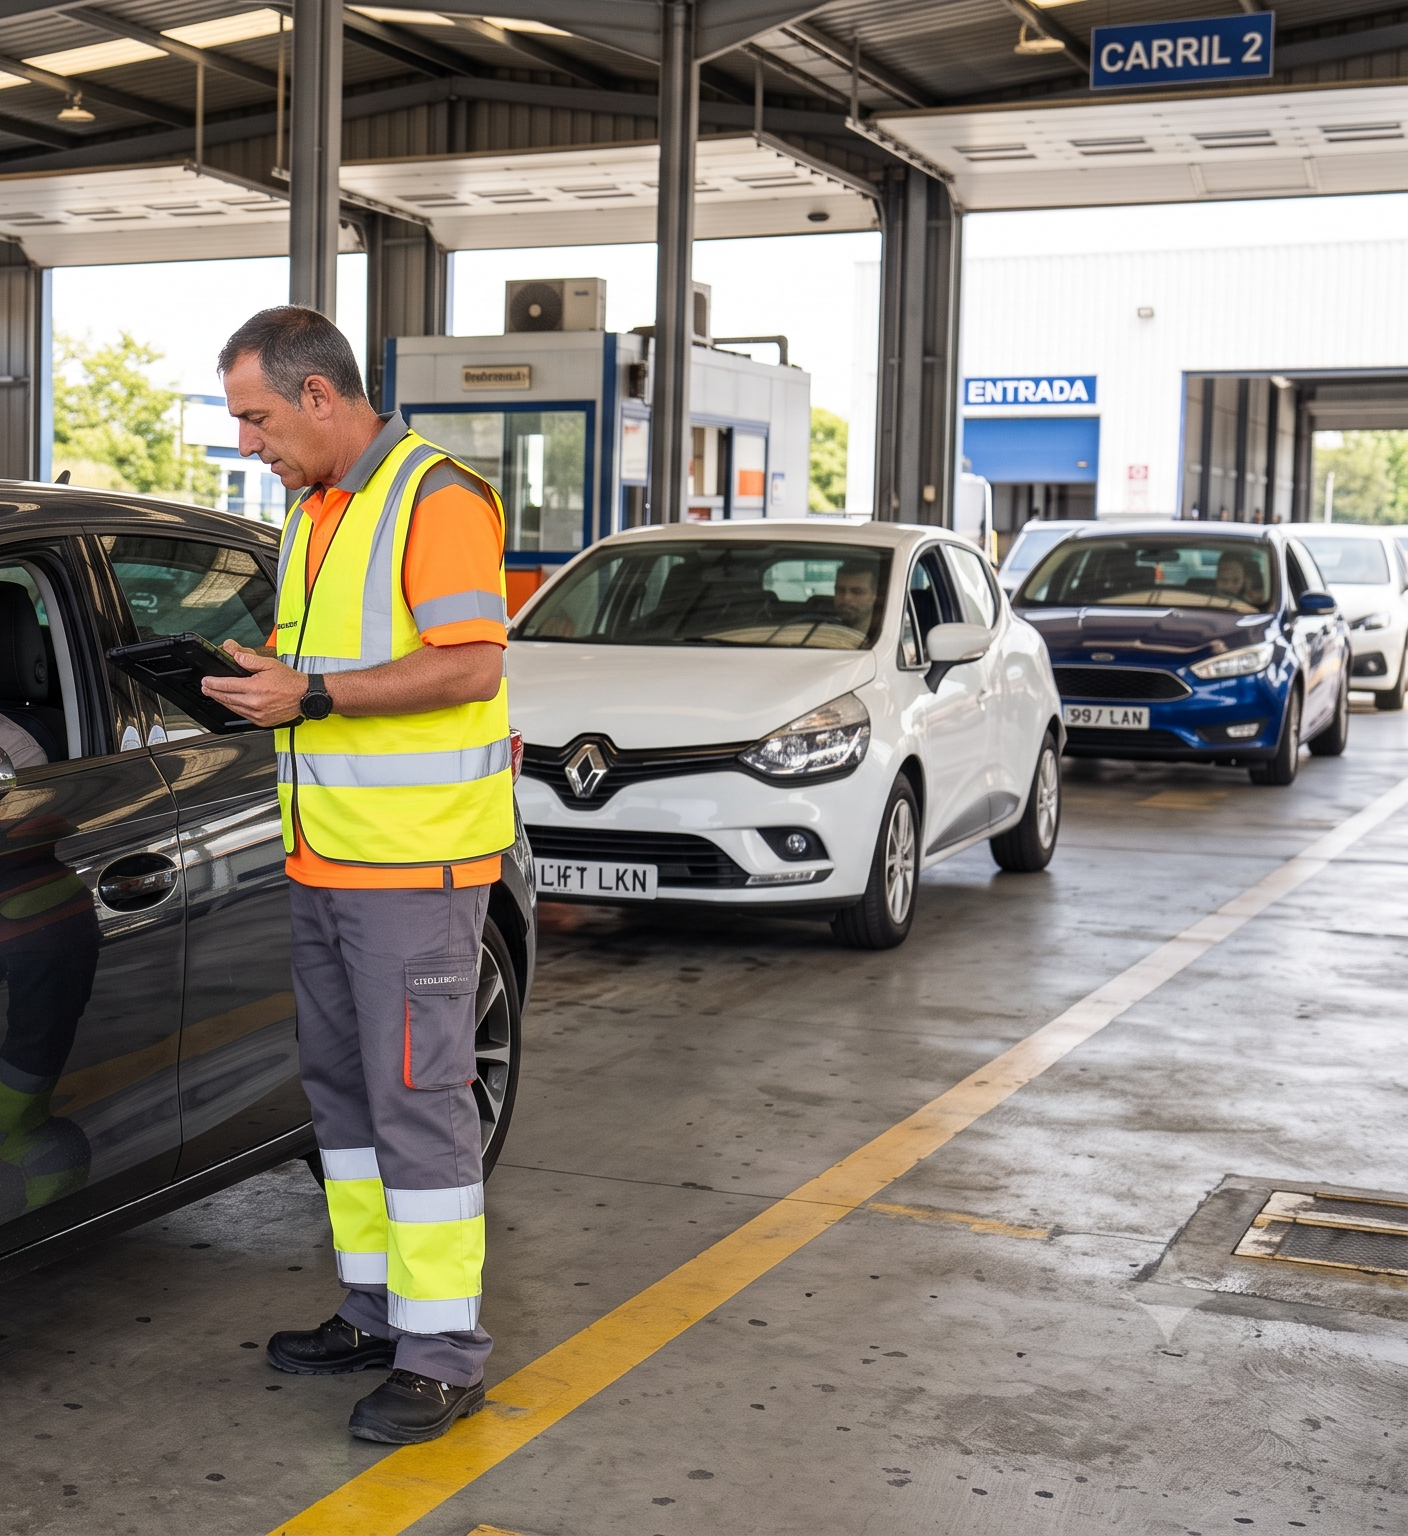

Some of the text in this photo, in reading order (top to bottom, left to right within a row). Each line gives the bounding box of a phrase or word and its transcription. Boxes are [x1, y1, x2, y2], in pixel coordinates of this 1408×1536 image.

[1100, 31, 1264, 73] CARRIL 2
[968, 379, 1090, 403] ENTRADA
[1109, 710, 1143, 725] LAN
[598, 867, 647, 892] LKN
